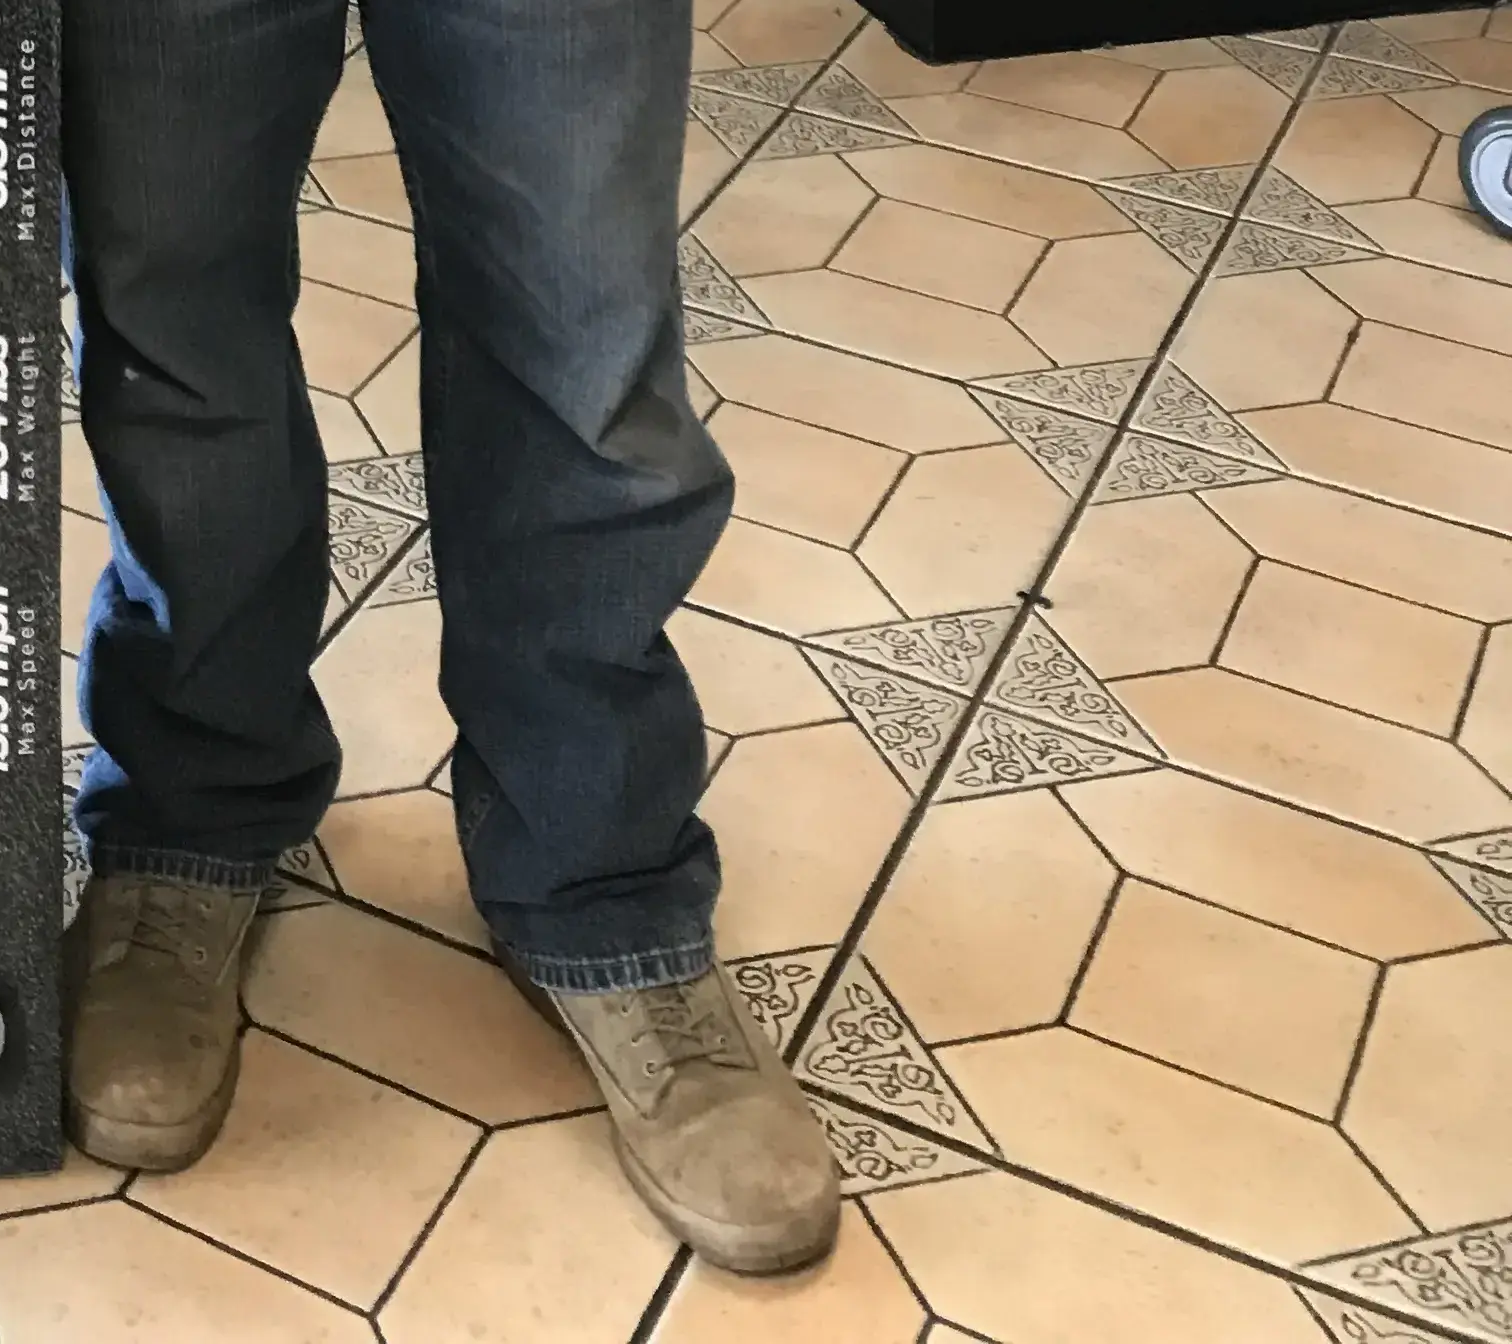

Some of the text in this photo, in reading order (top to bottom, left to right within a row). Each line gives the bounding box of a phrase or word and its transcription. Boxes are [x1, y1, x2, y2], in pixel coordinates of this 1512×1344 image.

[16, 39, 38, 241] Max Distance
[17, 332, 40, 506] Max Weight
[17, 605, 40, 755] Max Speed
